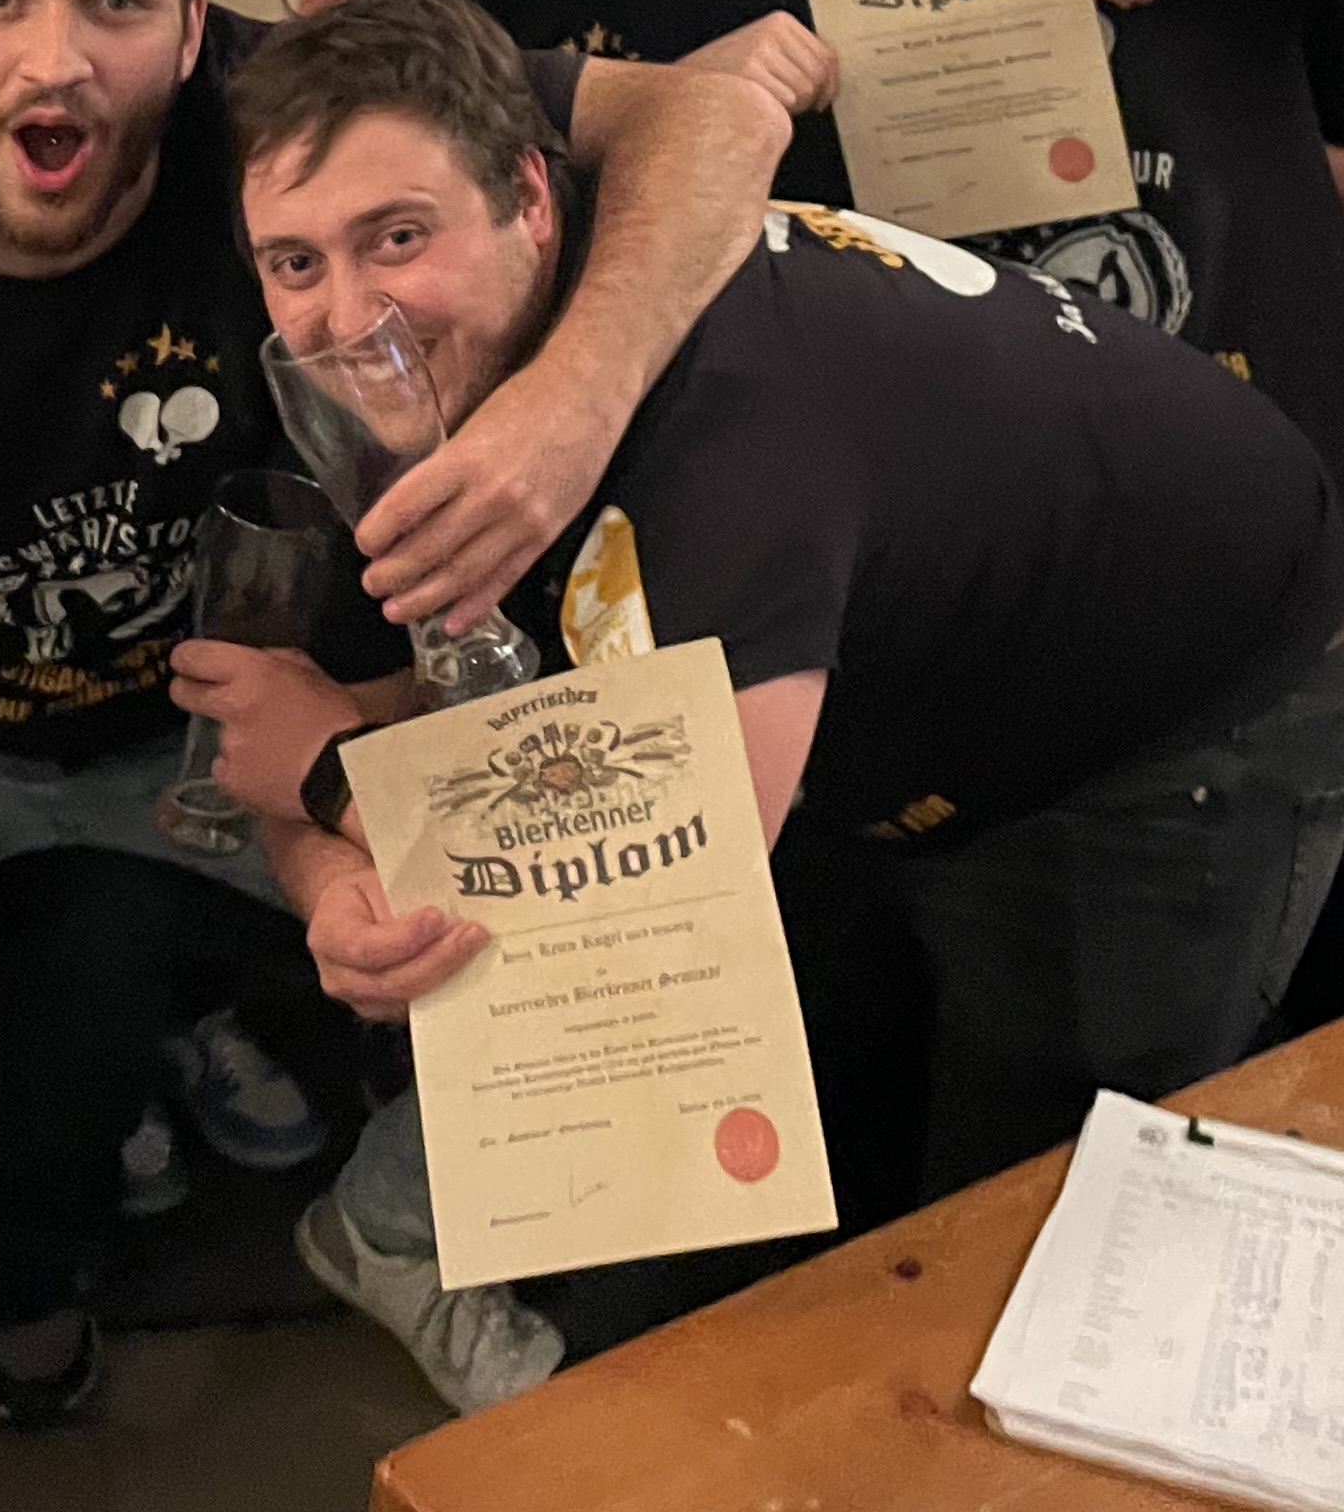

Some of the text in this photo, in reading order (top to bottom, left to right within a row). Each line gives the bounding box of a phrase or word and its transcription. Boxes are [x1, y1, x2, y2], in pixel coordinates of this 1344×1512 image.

[32, 479, 139, 529] LETZTE
[494, 798, 655, 851] Bierkenner
[444, 810, 708, 902] Diplom
